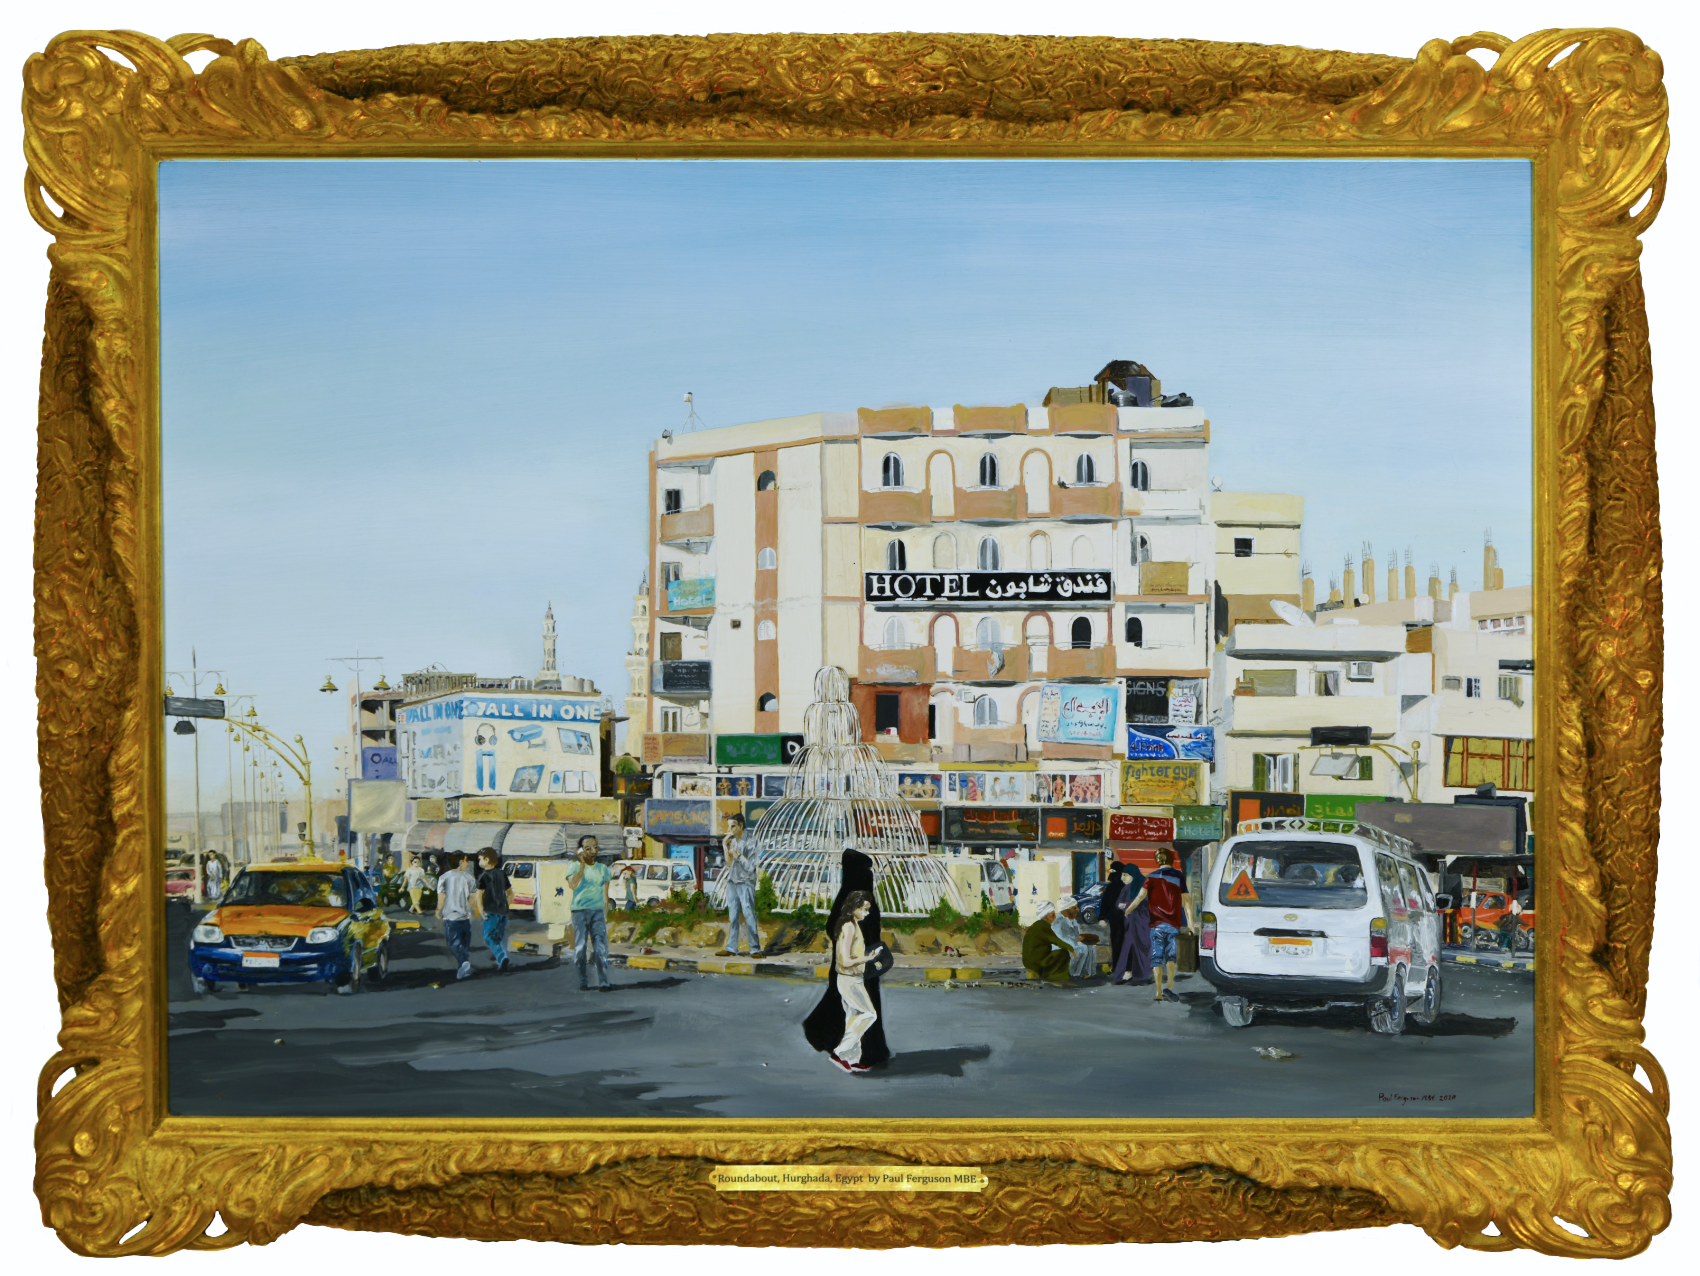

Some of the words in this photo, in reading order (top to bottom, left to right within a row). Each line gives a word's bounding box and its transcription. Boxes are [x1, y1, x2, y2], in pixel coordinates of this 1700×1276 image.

[869, 574, 979, 598] HOTEL
[985, 573, 1052, 599] شابون
[1056, 573, 1108, 598] فندق
[673, 594, 706, 607] Hotel
[485, 703, 525, 718] ALL
[531, 704, 553, 718] IN
[560, 704, 600, 721] ONE
[1125, 764, 1171, 782] fighter
[648, 810, 710, 826] SAMSUNG
[718, 1173, 780, 1184] Roundabout,
[782, 1173, 833, 1185] Hurghada,
[835, 1174, 863, 1185] Egypt
[868, 1174, 880, 1185] by
[882, 1174, 904, 1183] Paul
[906, 1174, 951, 1185] Ferguson
[954, 1174, 977, 1184] MBE
